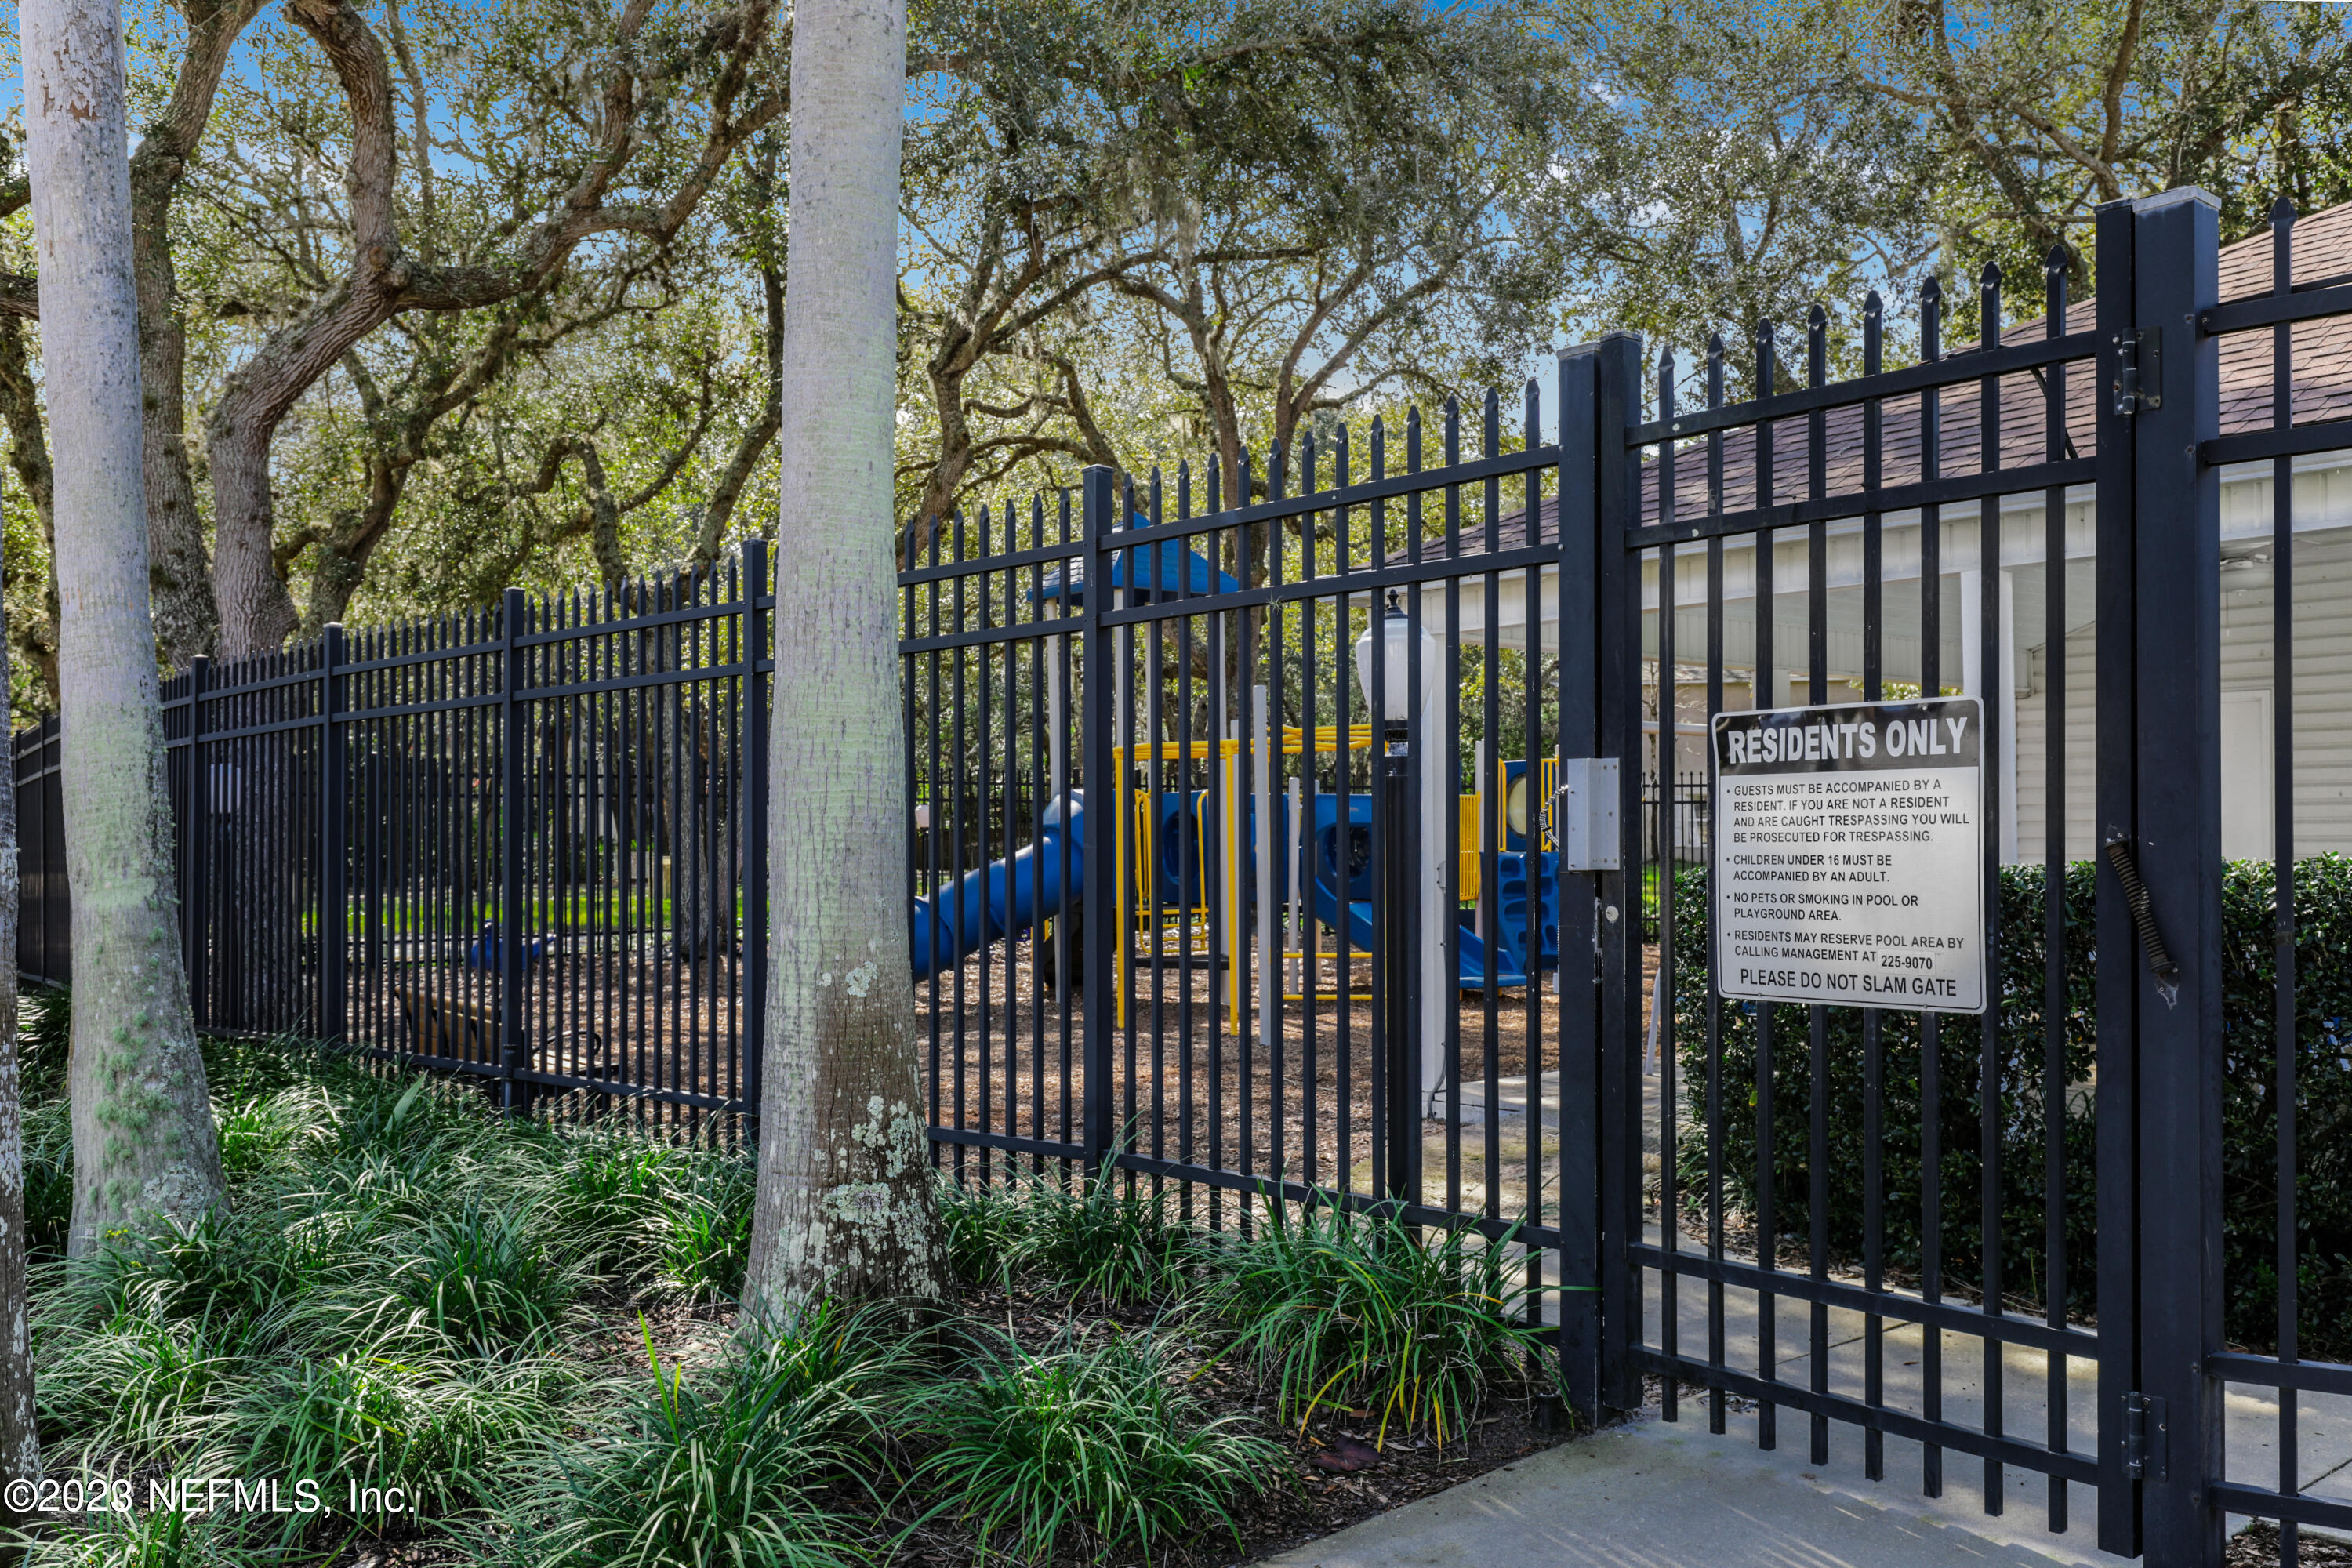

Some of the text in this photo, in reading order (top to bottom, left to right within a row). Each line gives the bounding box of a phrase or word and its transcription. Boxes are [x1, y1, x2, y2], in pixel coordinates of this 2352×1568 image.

[1727, 717, 1967, 764] RESIDENTS ONLY
[1734, 779, 1941, 796] GUESTS MUST BE ACCOMPANIED BY A
[1733, 796, 1949, 811] RESIDENT. IF YOU ARE NOT A RESIDENT
[1733, 813, 1969, 826] AND ARE CAUGHT TRESPASSING YOU WILL
[1733, 830, 1934, 842] BE PROSECUTED FOR TRESPASSING.
[1733, 855, 1891, 866] CHILDREN UNDER 16 MUST BE
[1733, 870, 1889, 881] ACCOMPANIED BY AN ADULT.
[1733, 892, 1918, 906] NO PETS OR SMOKING IN POOL OR
[1734, 907, 1841, 920] PLAYGROUND AREA.
[1734, 930, 1963, 948] RESIDENTS MAY RESERVE POOL AREA BY
[1734, 946, 1932, 969] CALLING MANAGEMENT AT 225-9070
[1740, 968, 1956, 996] PLEASE DO NOT SLAM GATE
